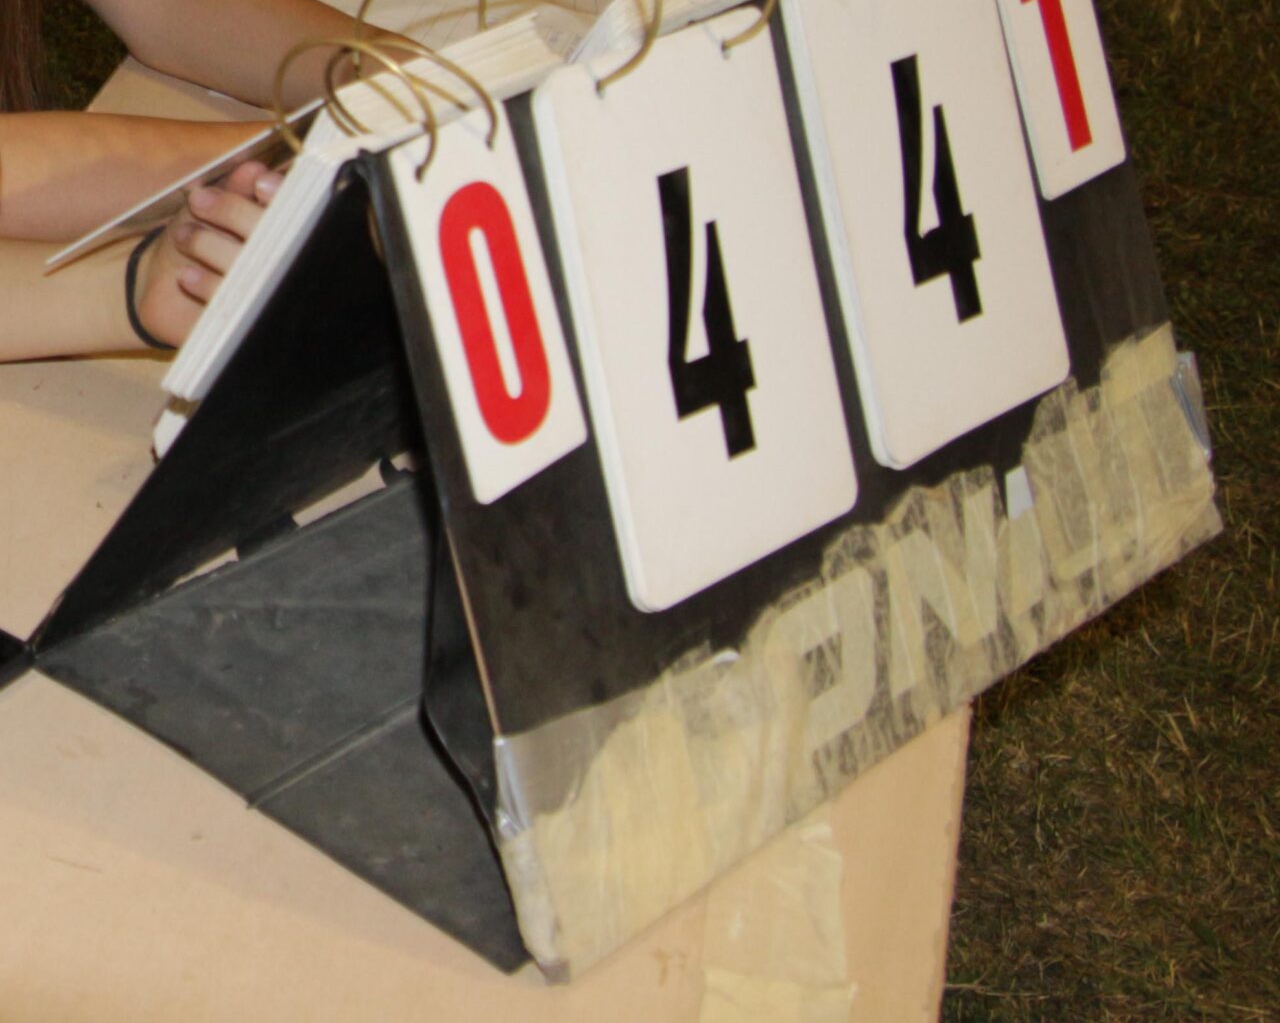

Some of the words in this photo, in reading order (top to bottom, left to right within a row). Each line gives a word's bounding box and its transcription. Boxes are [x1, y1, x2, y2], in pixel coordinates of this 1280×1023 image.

[438, 180, 552, 446] 0
[656, 166, 758, 461] 4
[889, 53, 983, 325] 4
